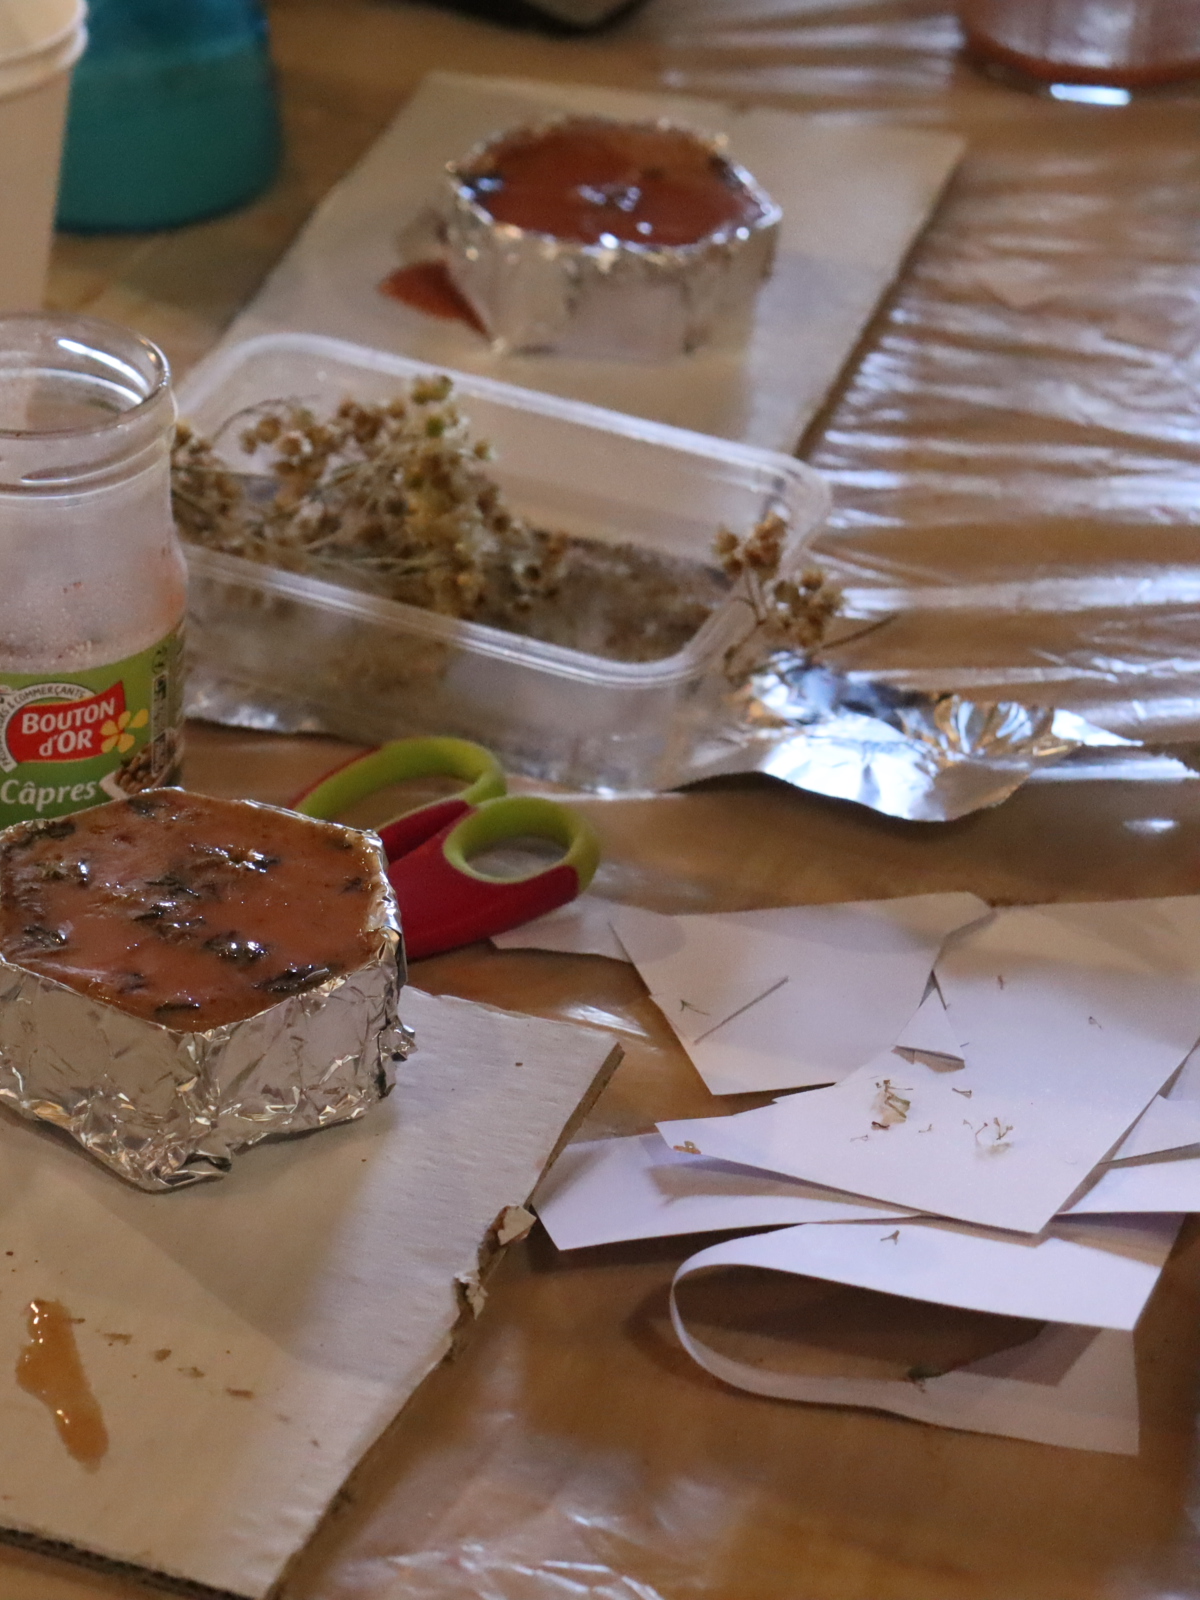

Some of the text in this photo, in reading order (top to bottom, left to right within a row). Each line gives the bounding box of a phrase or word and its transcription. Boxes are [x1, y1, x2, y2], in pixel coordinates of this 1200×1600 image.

[13, 685, 86, 704] COMMERÇANTS
[21, 697, 115, 735] BOUTON
[39, 729, 94, 757] d'OR
[0, 779, 98, 812] Câpres
